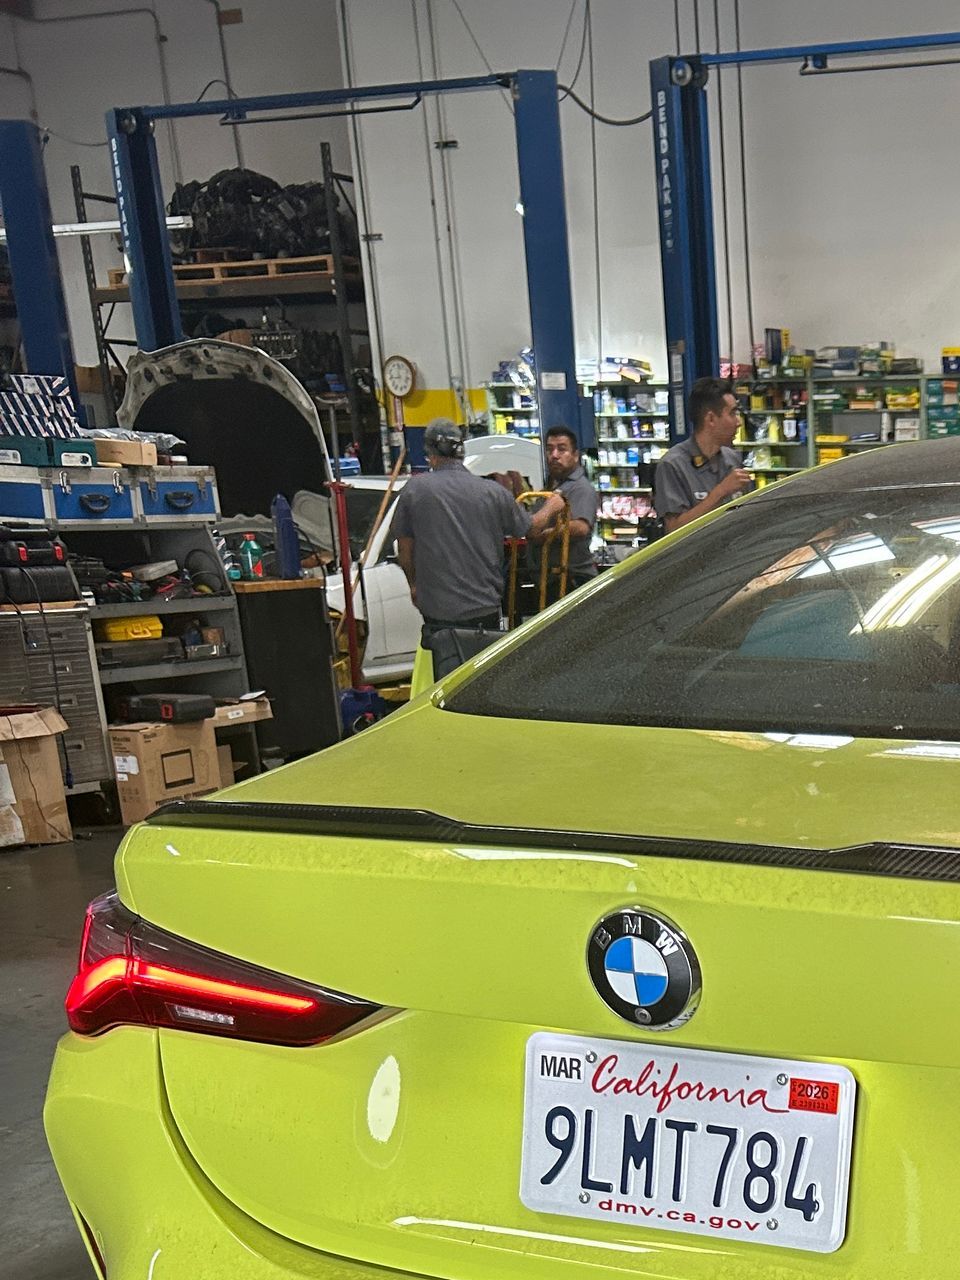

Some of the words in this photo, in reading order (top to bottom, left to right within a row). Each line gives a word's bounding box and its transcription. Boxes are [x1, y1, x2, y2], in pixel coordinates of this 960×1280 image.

[657, 90, 669, 154] BEND
[661, 158, 672, 204] PAK
[594, 915, 679, 957] BMW
[541, 1055, 582, 1080] MAR
[591, 1054, 790, 1114] California
[797, 1083, 829, 1100] 2026
[541, 1105, 820, 1222] 9LMT784
[598, 1199, 760, 1232] dmv.ca.gov
